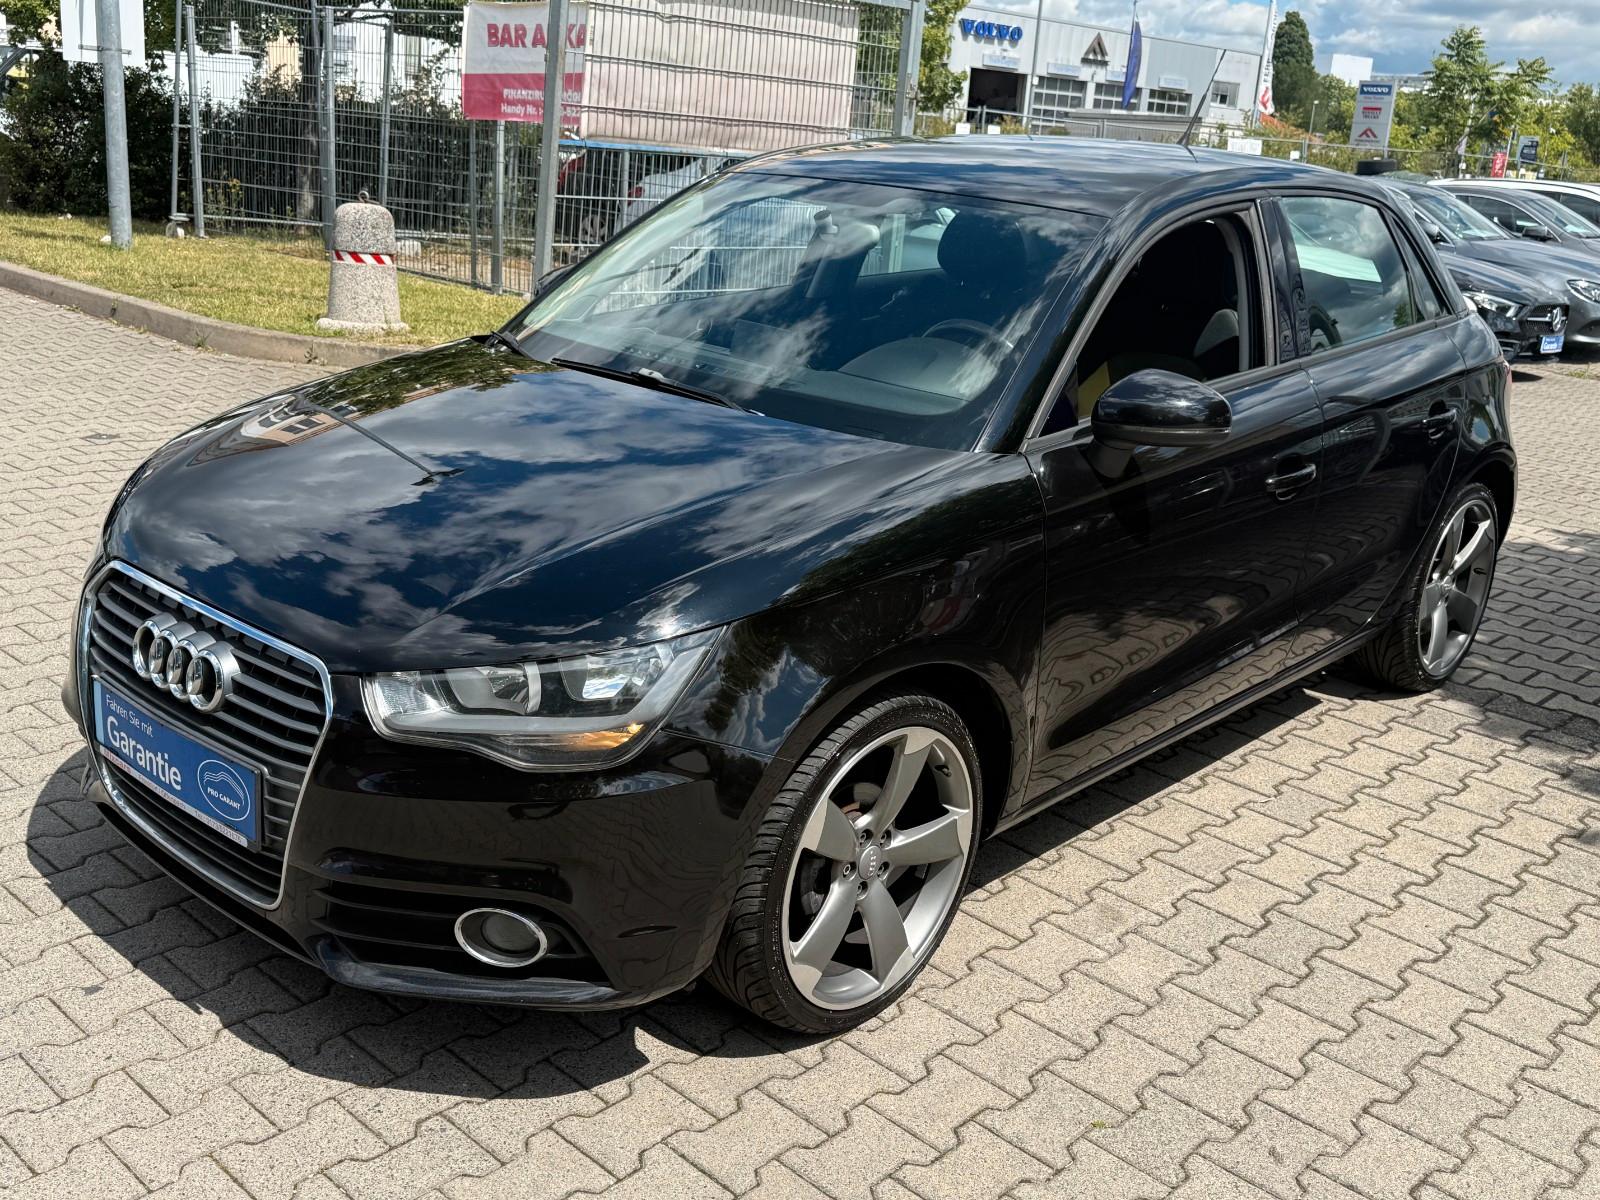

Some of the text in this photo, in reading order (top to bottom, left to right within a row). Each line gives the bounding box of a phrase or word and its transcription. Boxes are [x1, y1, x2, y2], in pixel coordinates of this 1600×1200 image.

[487, 23, 587, 48] BAR AKA
[959, 18, 1023, 41] VOLVO
[503, 88, 545, 101] FINANZIRU
[500, 102, 525, 117] Handy
[106, 694, 154, 738] Fahren Sie mit
[107, 715, 182, 790] Garantie
[207, 786, 240, 810] PRO GARANT
